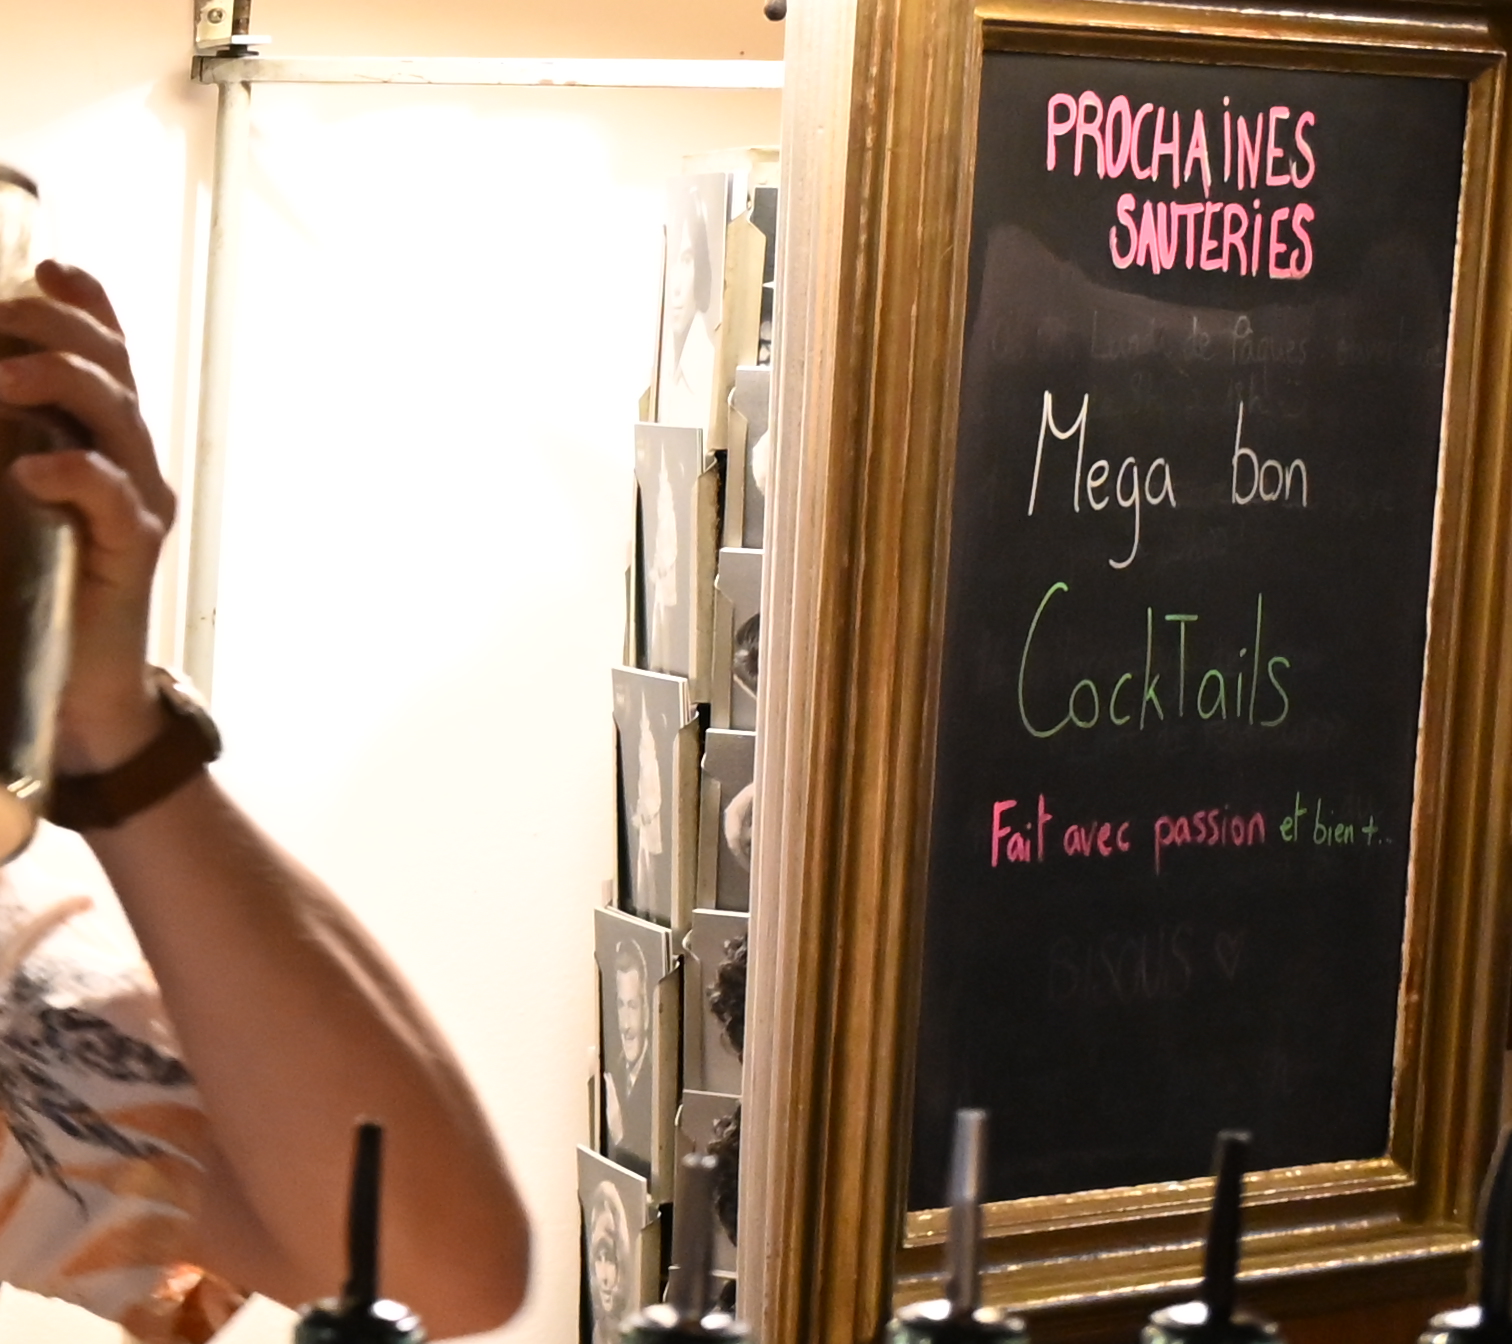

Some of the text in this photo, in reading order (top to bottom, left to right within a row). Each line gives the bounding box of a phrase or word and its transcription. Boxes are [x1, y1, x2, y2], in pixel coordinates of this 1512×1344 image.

[1046, 90, 1315, 199] PROCHAINES
[1109, 193, 1315, 280] SAUTERIES
[1027, 389, 1309, 569] Mega bon
[991, 793, 1053, 867] Fait
[1063, 818, 1131, 857] avec
[1154, 808, 1266, 875] passion
[1279, 790, 1308, 843] et
[1313, 797, 1355, 847] bien
